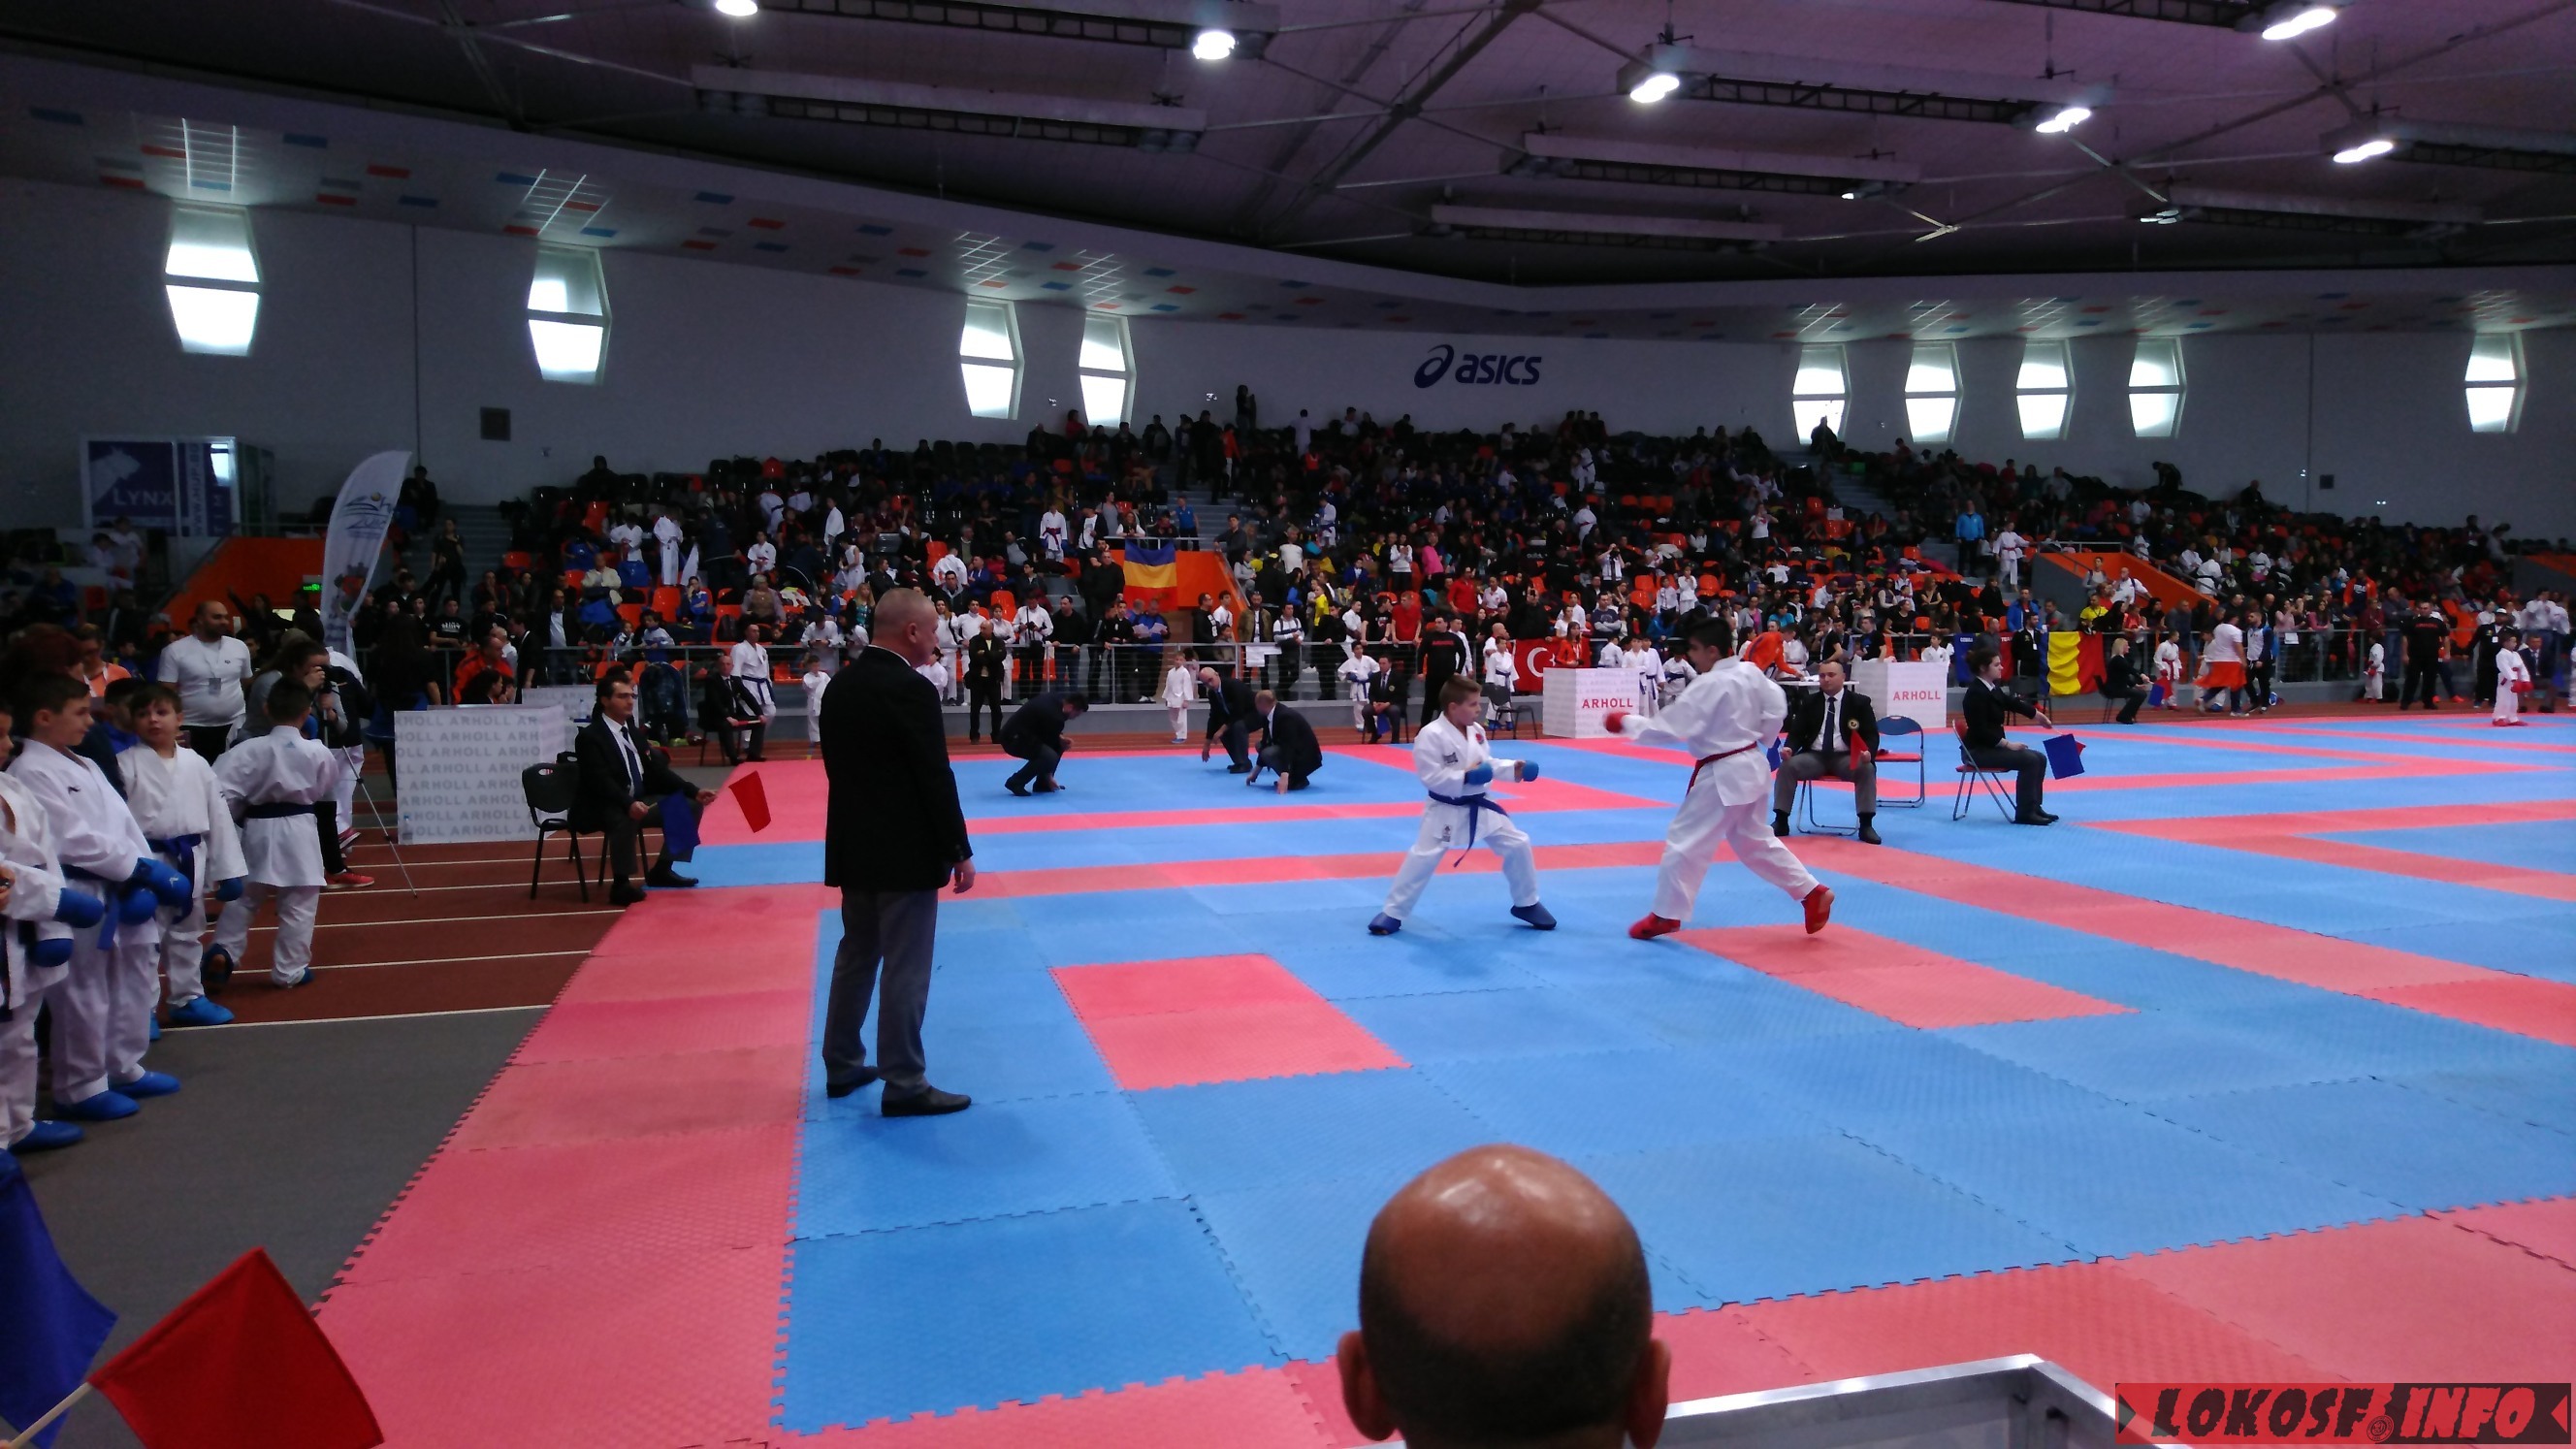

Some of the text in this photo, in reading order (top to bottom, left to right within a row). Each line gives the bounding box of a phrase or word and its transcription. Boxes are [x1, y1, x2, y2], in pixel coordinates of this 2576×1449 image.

[1455, 354, 1542, 385] asics
[113, 488, 175, 505] LYNX
[1893, 691, 1941, 700] ARHOLL
[1582, 698, 1633, 709] ARHOLL
[449, 716, 511, 726] ARHOLL
[439, 731, 501, 742] ARHOLL
[507, 731, 538, 741] ARH
[396, 746, 540, 757] OLL ARHOLL ARHO
[421, 763, 482, 774] ARHOLL
[410, 780, 471, 790] ARHOLL
[400, 795, 462, 806] ARHOLL
[460, 810, 521, 821] ARHOLL
[449, 824, 512, 836] ARHOLL
